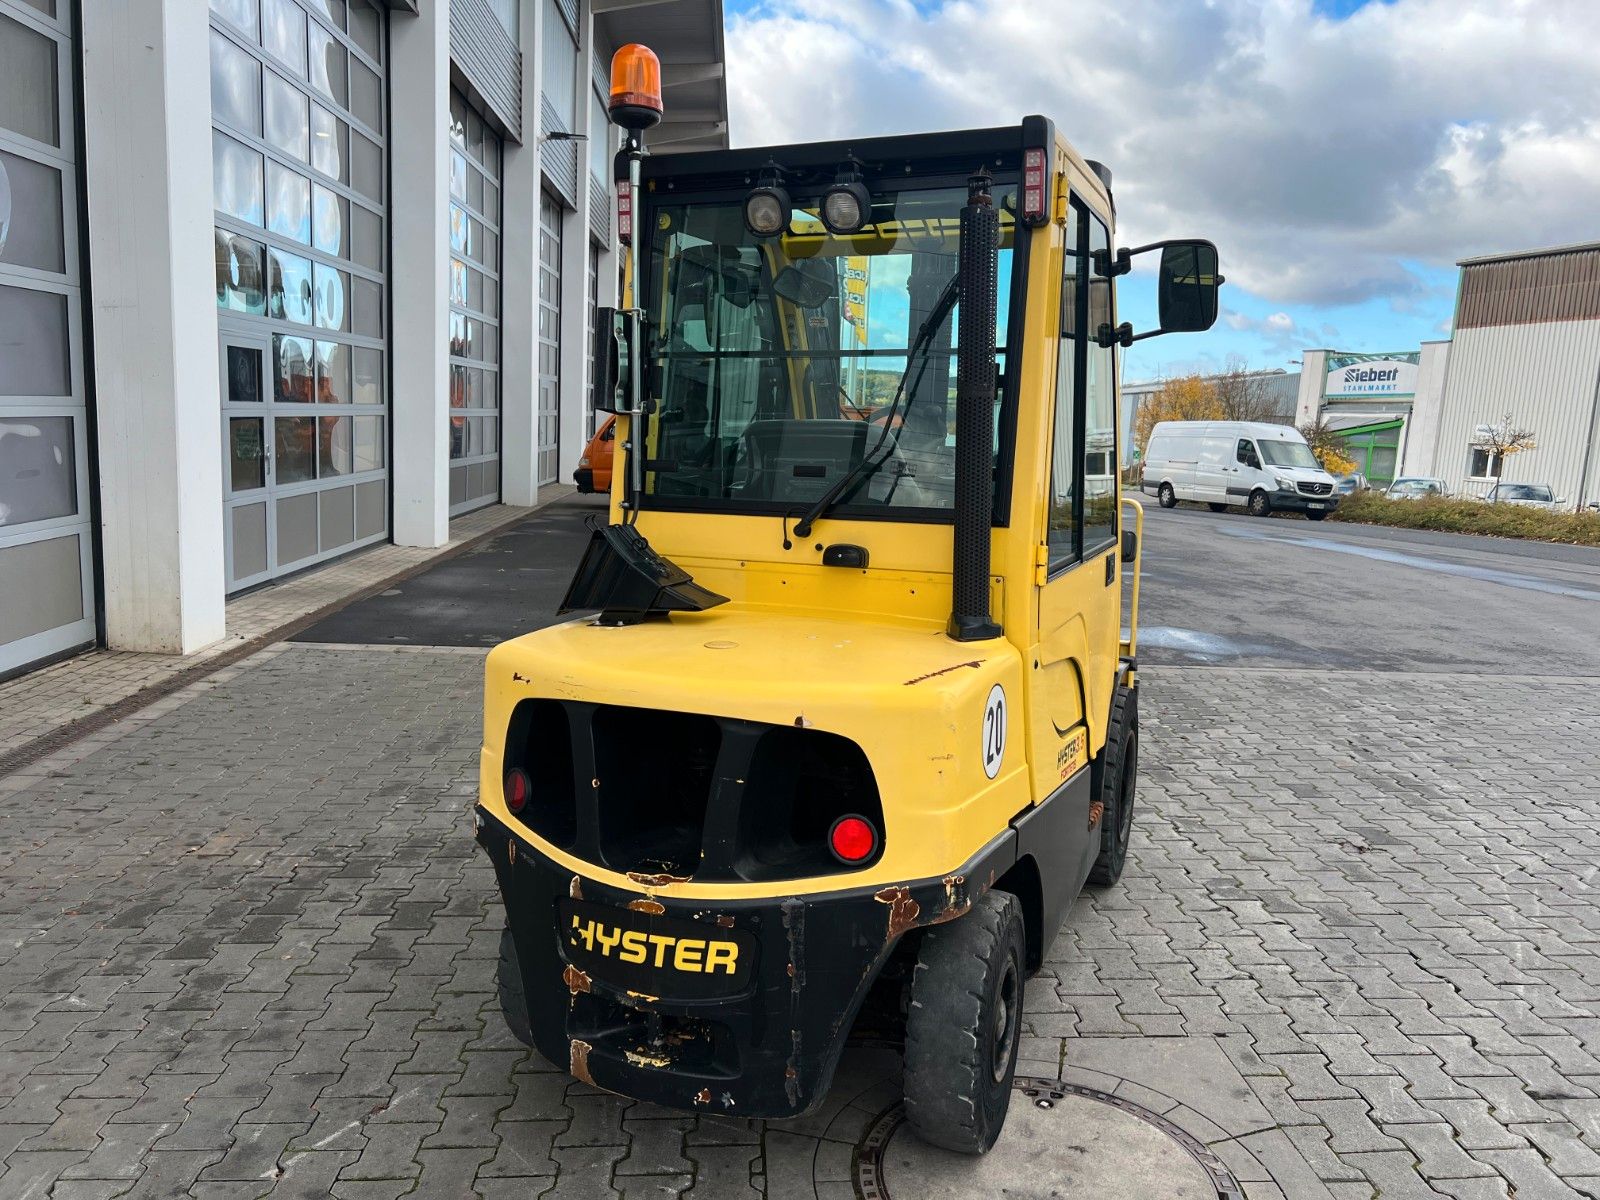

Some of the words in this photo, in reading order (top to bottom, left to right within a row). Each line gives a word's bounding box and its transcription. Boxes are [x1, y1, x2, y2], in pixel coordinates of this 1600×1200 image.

[1343, 384, 1397, 392] STAHLMARKT
[1344, 367, 1398, 382] Siebert
[987, 700, 1003, 766] 20
[571, 915, 739, 975] HYSTER
